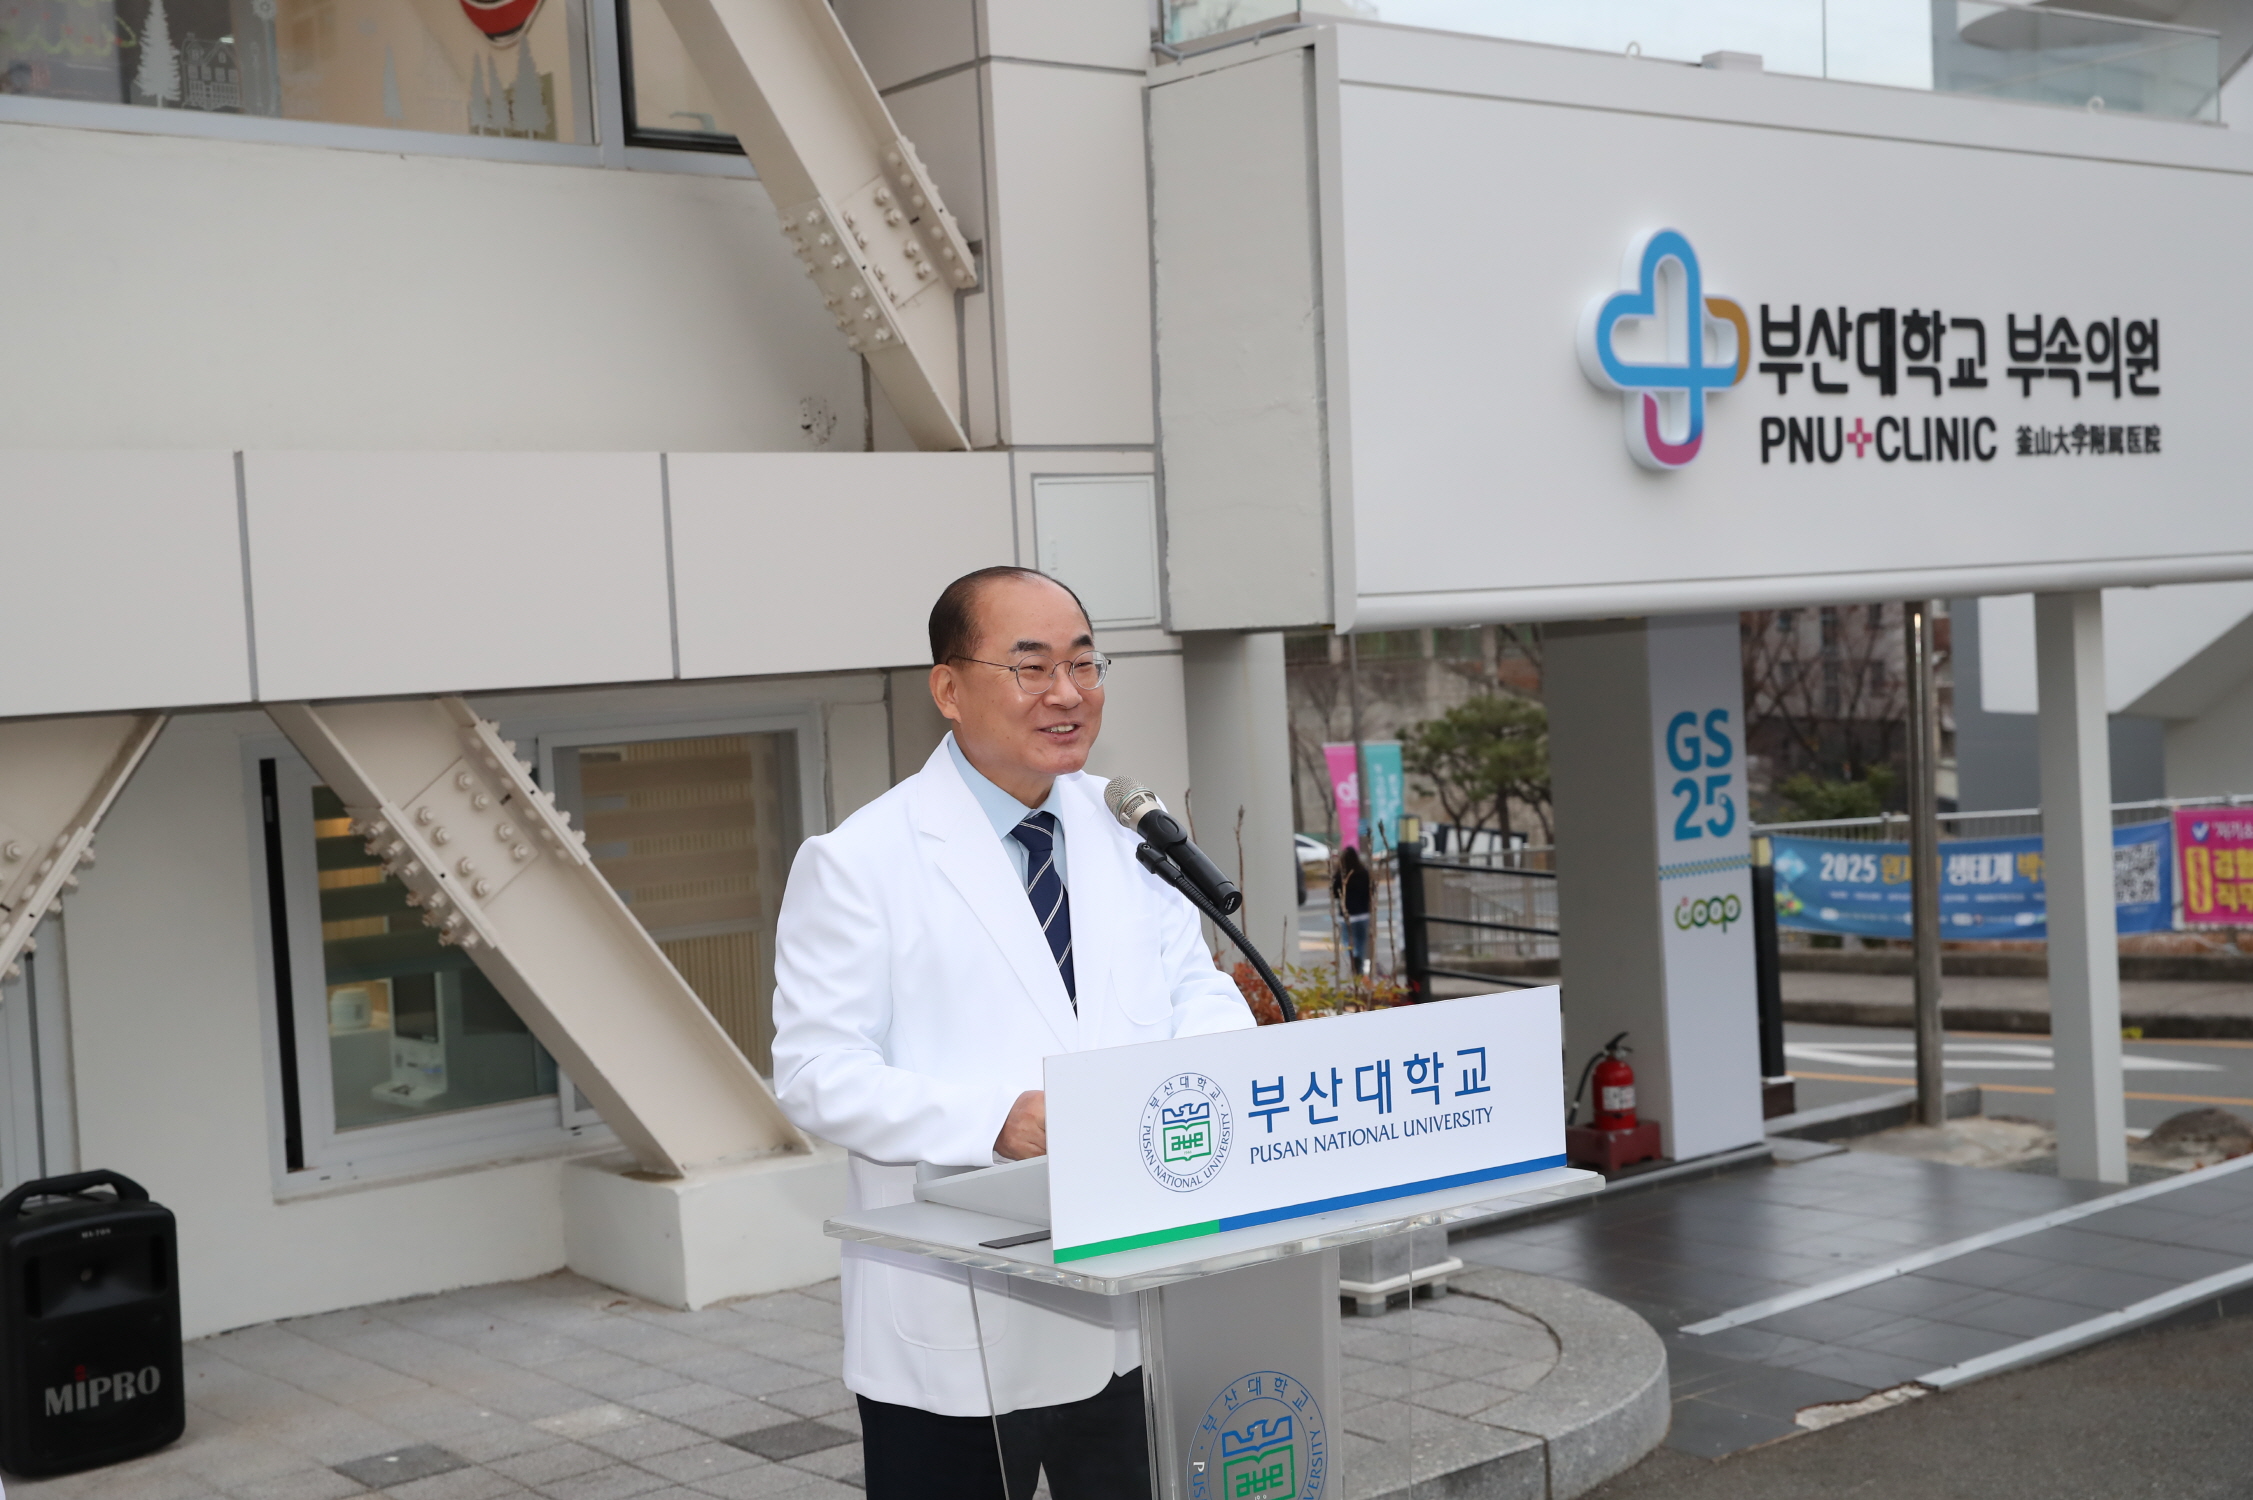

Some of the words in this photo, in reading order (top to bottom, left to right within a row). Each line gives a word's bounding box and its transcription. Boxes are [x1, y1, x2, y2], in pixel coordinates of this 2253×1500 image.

[1759, 304, 1988, 397] 부산대학교
[2007, 313, 2160, 399] 부속의원
[1666, 708, 1733, 772] GS
[1672, 774, 1736, 842] 25
[1819, 853, 1877, 883] 2025
[1947, 852, 2014, 886] 생태계
[1149, 1075, 1221, 1109] 부산대학교
[1248, 1047, 1491, 1133] 부산대학교
[1142, 1125, 1156, 1166] PUSAN
[1153, 1165, 1203, 1188] NATIONAL
[1203, 1112, 1231, 1179] UNIVERSITY
[1250, 1138, 1308, 1164] PUSAN
[1314, 1123, 1399, 1153] NATIONAL
[1403, 1106, 1493, 1137] UNIVERSITY
[45, 1365, 161, 1416] MIPRO
[1202, 1376, 1309, 1435] 부산대학교
[1192, 1461, 1207, 1500] PUS
